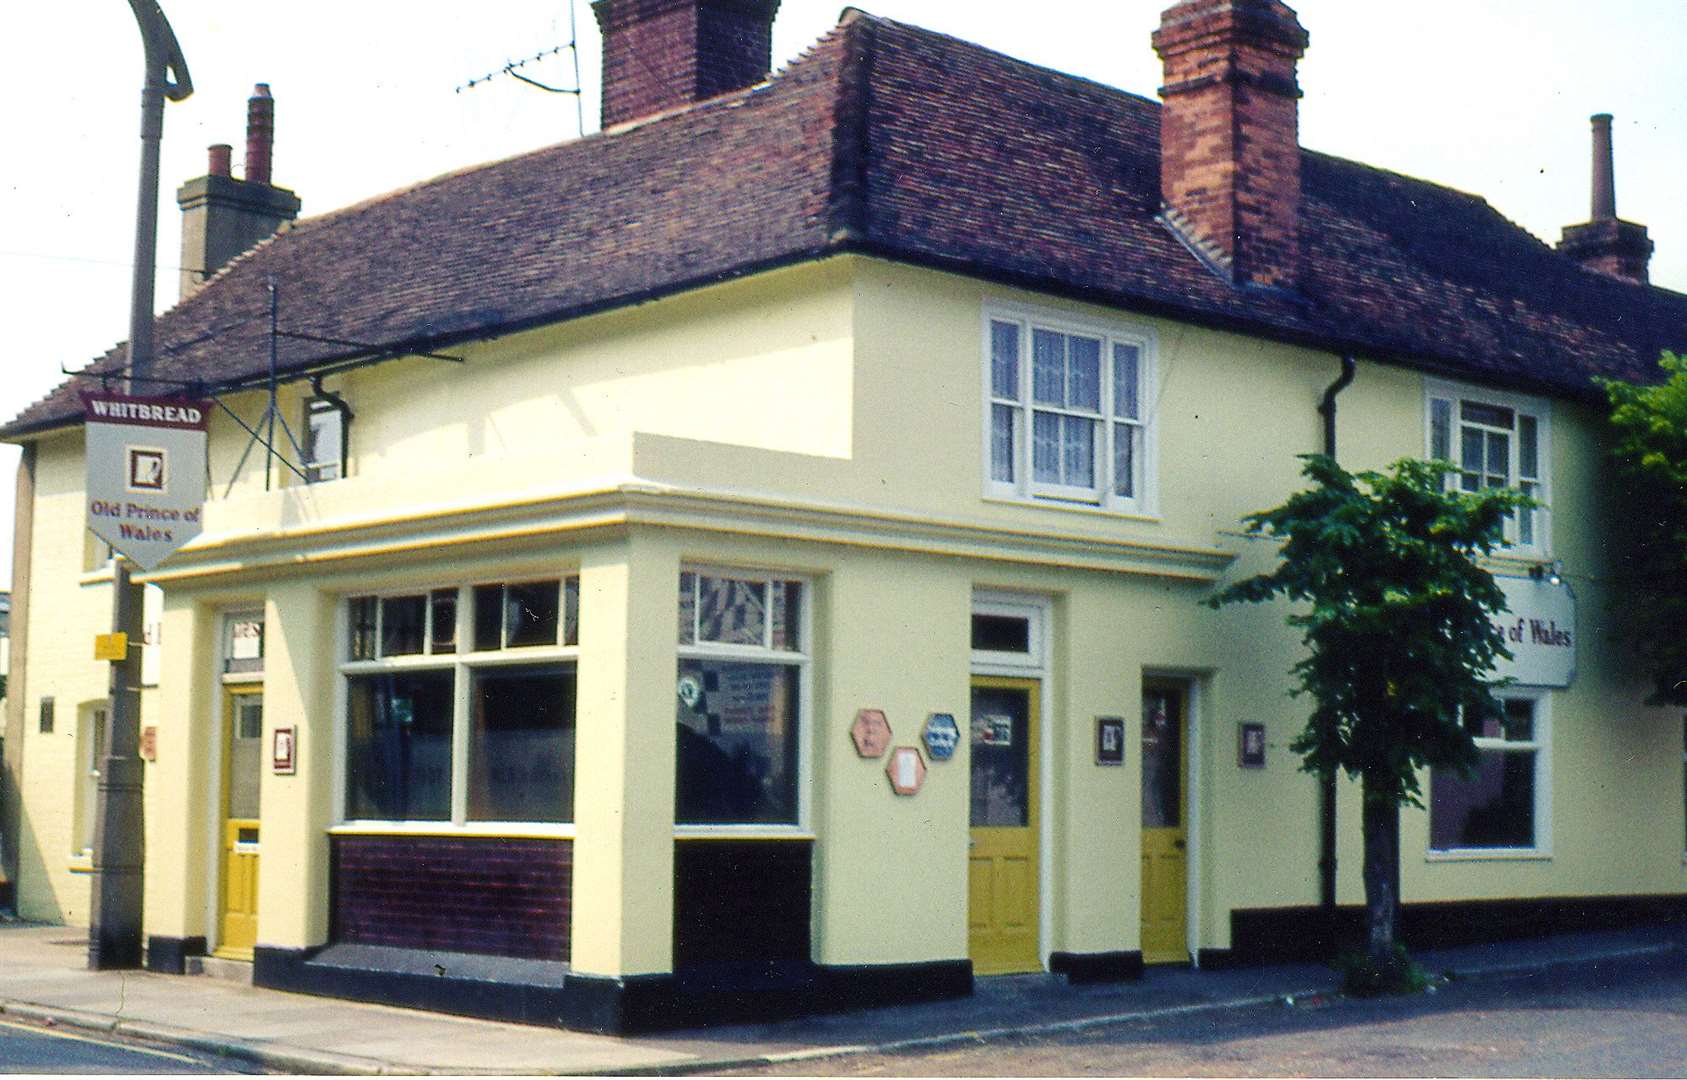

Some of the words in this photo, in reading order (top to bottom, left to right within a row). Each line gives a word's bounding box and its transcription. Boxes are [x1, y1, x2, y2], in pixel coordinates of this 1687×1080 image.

[91, 400, 202, 424] WHITBREAD
[91, 500, 121, 517] Old
[127, 502, 179, 520] Prince
[183, 507, 199, 522] of
[120, 523, 172, 542] Wales
[1509, 618, 1524, 643] of
[1529, 618, 1571, 647] Wales
